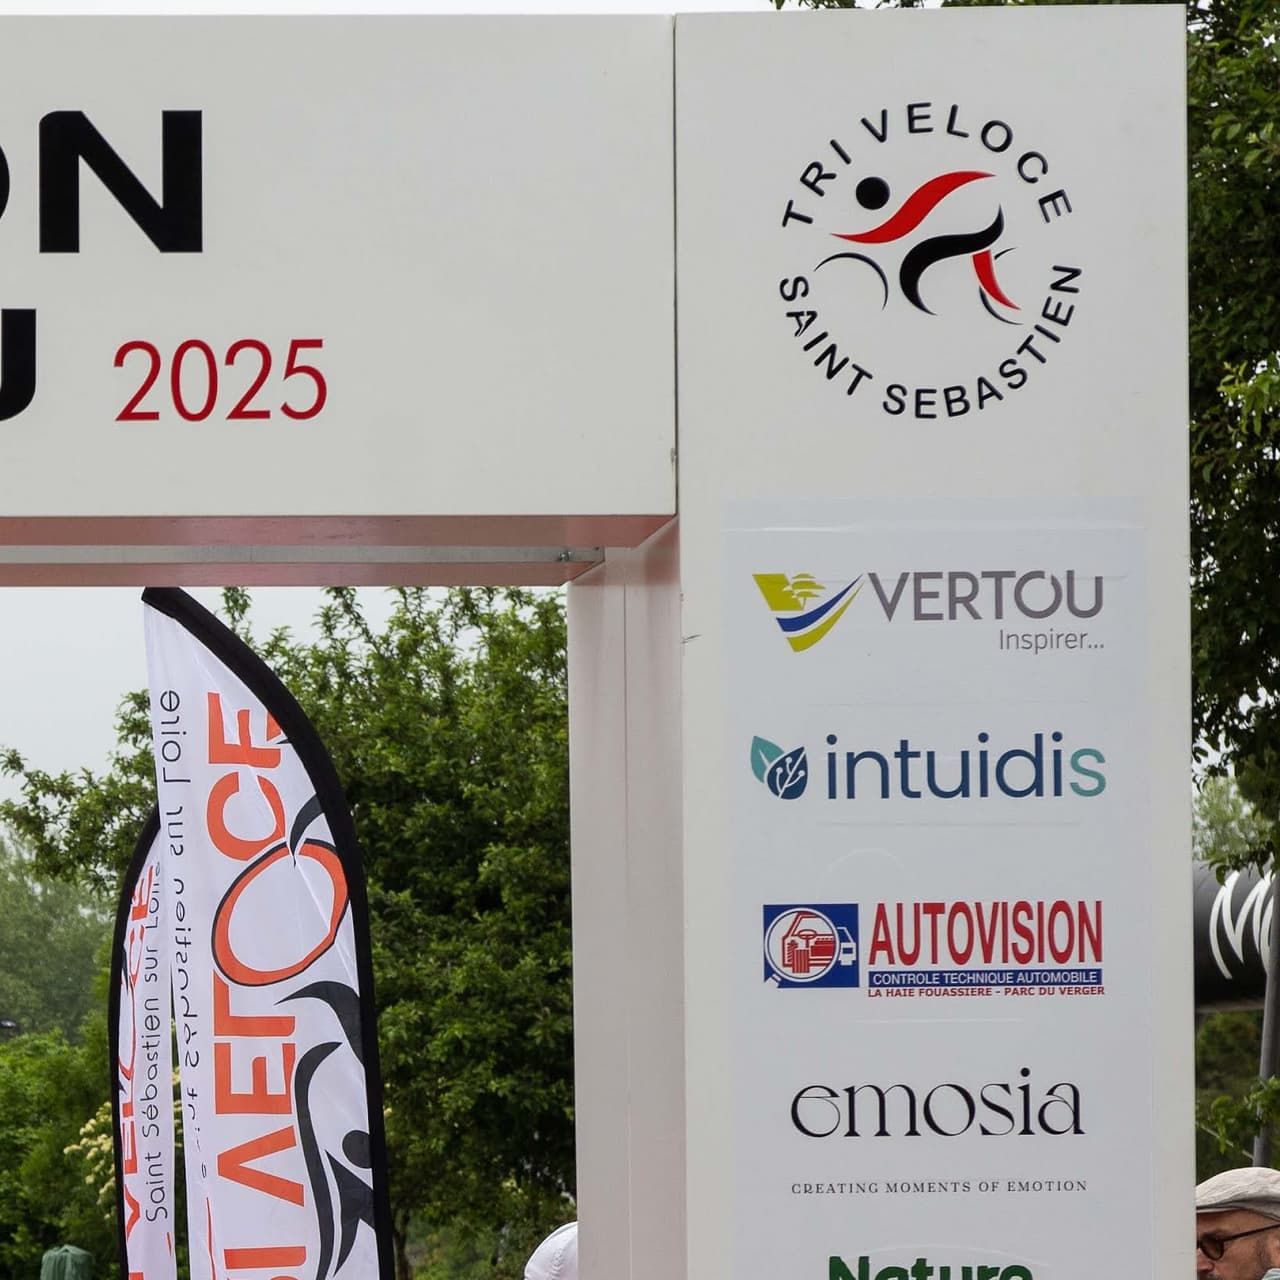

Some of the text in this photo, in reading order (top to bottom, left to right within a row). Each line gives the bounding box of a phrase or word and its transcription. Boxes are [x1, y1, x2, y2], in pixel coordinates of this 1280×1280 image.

[779, 265, 1082, 418] SAINT SEBASTIEN
[114, 339, 327, 421] 2025
[868, 570, 1103, 622] VERTOU
[827, 732, 1106, 799] intuidis
[869, 901, 1102, 966] AUTOVISION
[143, 951, 158, 991] sur
[868, 987, 1104, 997] LA HAIE FOUASSIERE PARC DU VERGER
[873, 972, 1096, 985] CONTROLE TECHNIQUE AUTOMOBILE
[141, 1012, 161, 1136] Sébastien
[791, 1068, 1085, 1137] emosia
[145, 1147, 169, 1222] Saint
[792, 1181, 1086, 1194] CREATING MOMENTS OF EMOTION
